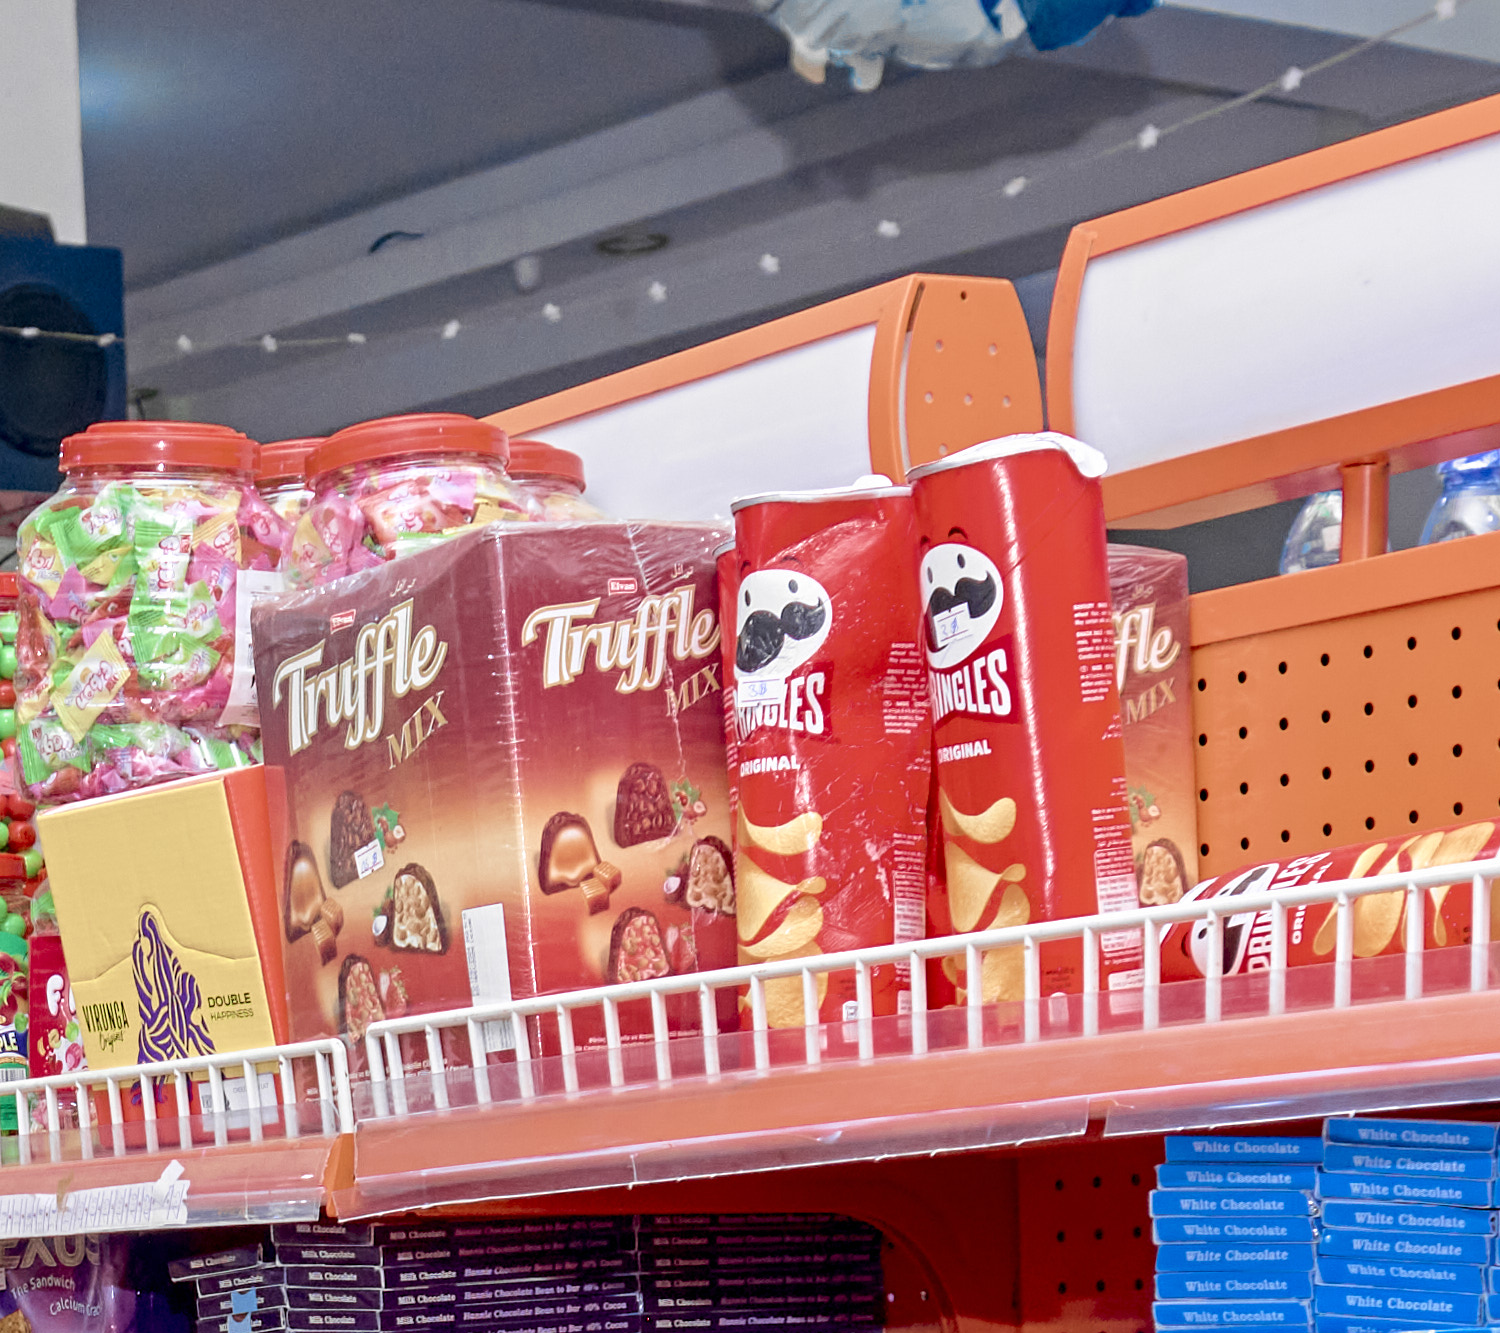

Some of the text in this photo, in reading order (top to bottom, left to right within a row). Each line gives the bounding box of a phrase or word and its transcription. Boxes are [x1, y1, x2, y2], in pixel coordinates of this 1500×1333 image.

[522, 584, 721, 694] Truffle
[273, 597, 449, 756] Truffle
[666, 664, 720, 718] MIX
[1125, 678, 1176, 725] MIX
[387, 690, 449, 770] MIX
[740, 755, 800, 777] ORIGINAL
[207, 992, 251, 1008] DOUBLE
[82, 1000, 130, 1033] VIRUNGA
[210, 1008, 254, 1022] HAPPINESS
[1357, 1128, 1470, 1146] White Chocolate
[1193, 1141, 1300, 1155] White Chocolate
[1349, 1183, 1463, 1199] White Chocolate
[1179, 1198, 1285, 1212] White Chocolate
[1185, 1249, 1289, 1263] White Chocolate
[11, 1274, 76, 1301] The Sandwich
[50, 1296, 85, 1316] Calcium
